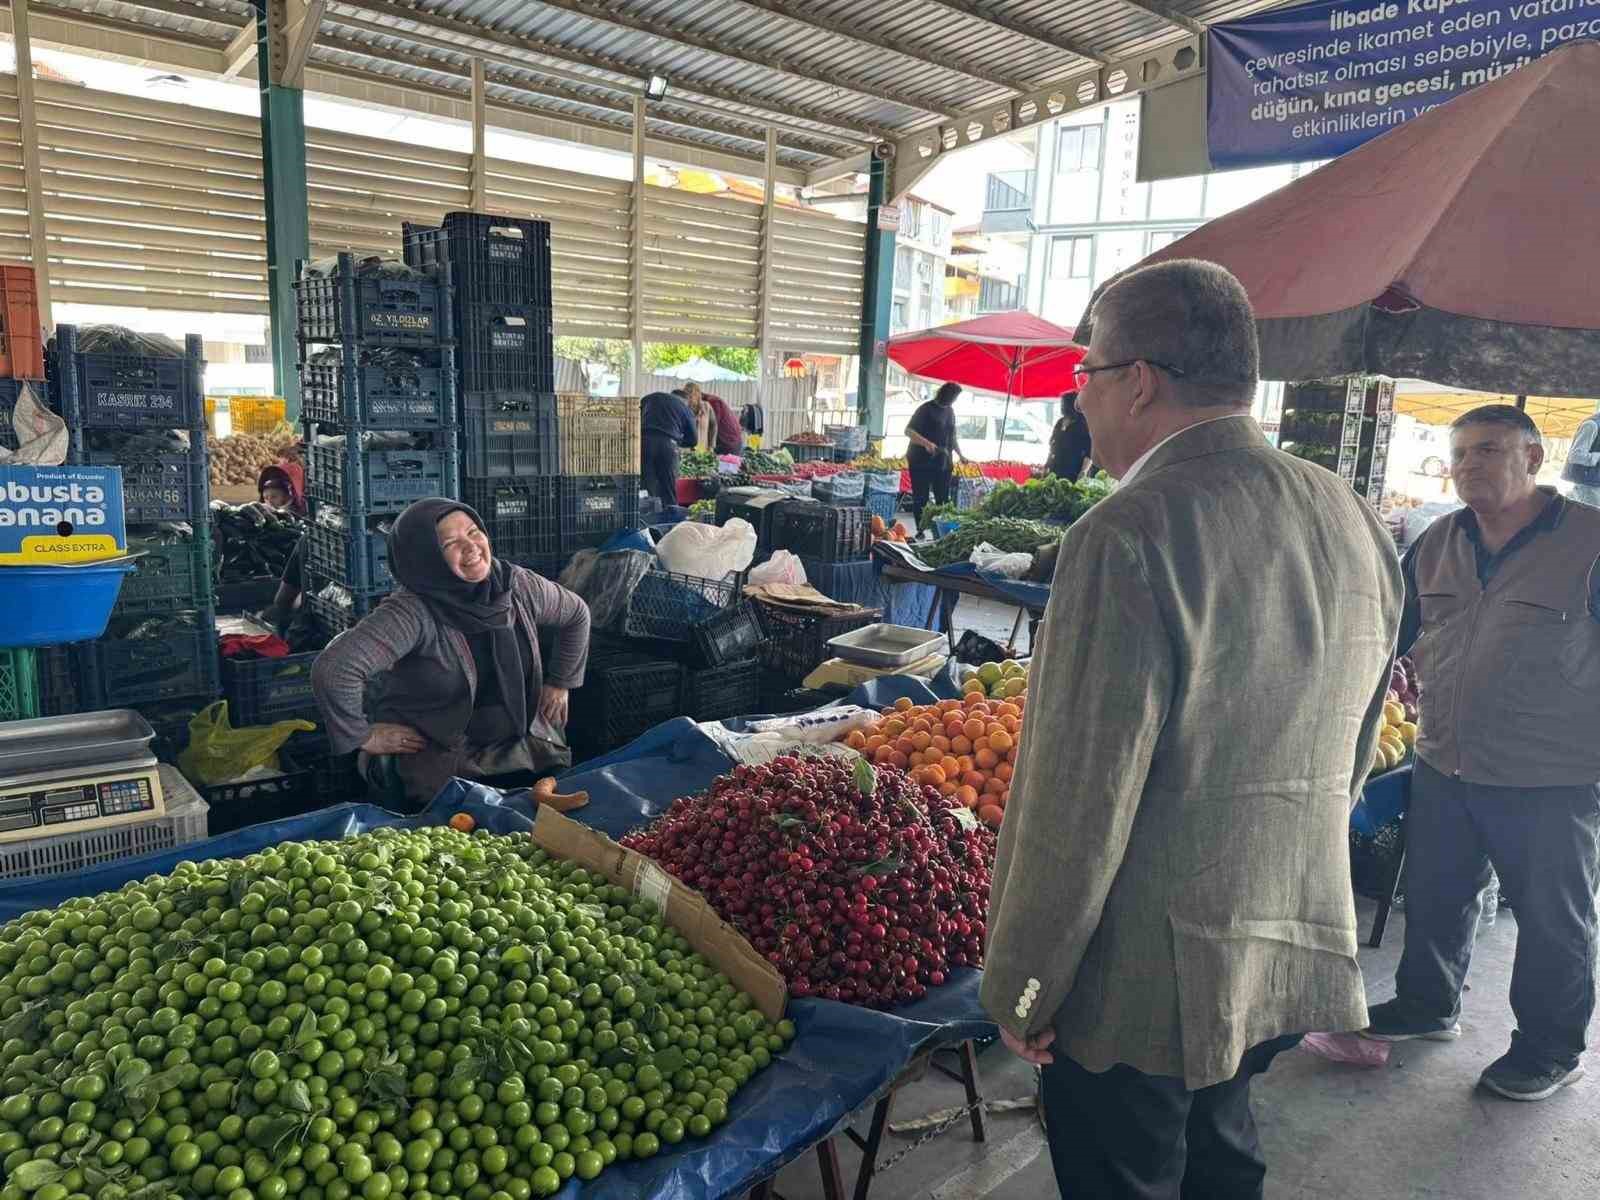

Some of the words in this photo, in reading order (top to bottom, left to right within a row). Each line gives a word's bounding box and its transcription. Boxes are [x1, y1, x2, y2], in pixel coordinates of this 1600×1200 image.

[1244, 38, 1352, 79] çevresinde
[1358, 20, 1434, 51] ikamet
[1441, 11, 1500, 35] eden
[1254, 70, 1329, 97] rahatsız
[1335, 55, 1406, 80] olması
[1414, 31, 1532, 68] sebebiyle,
[1251, 96, 1319, 121] düğün,
[1324, 87, 1371, 110] kına
[1375, 69, 1456, 105] gecesi,
[1292, 108, 1405, 138] etkinliklerin
[34, 544, 71, 553] CLASS
[73, 543, 106, 552] EXTRA
